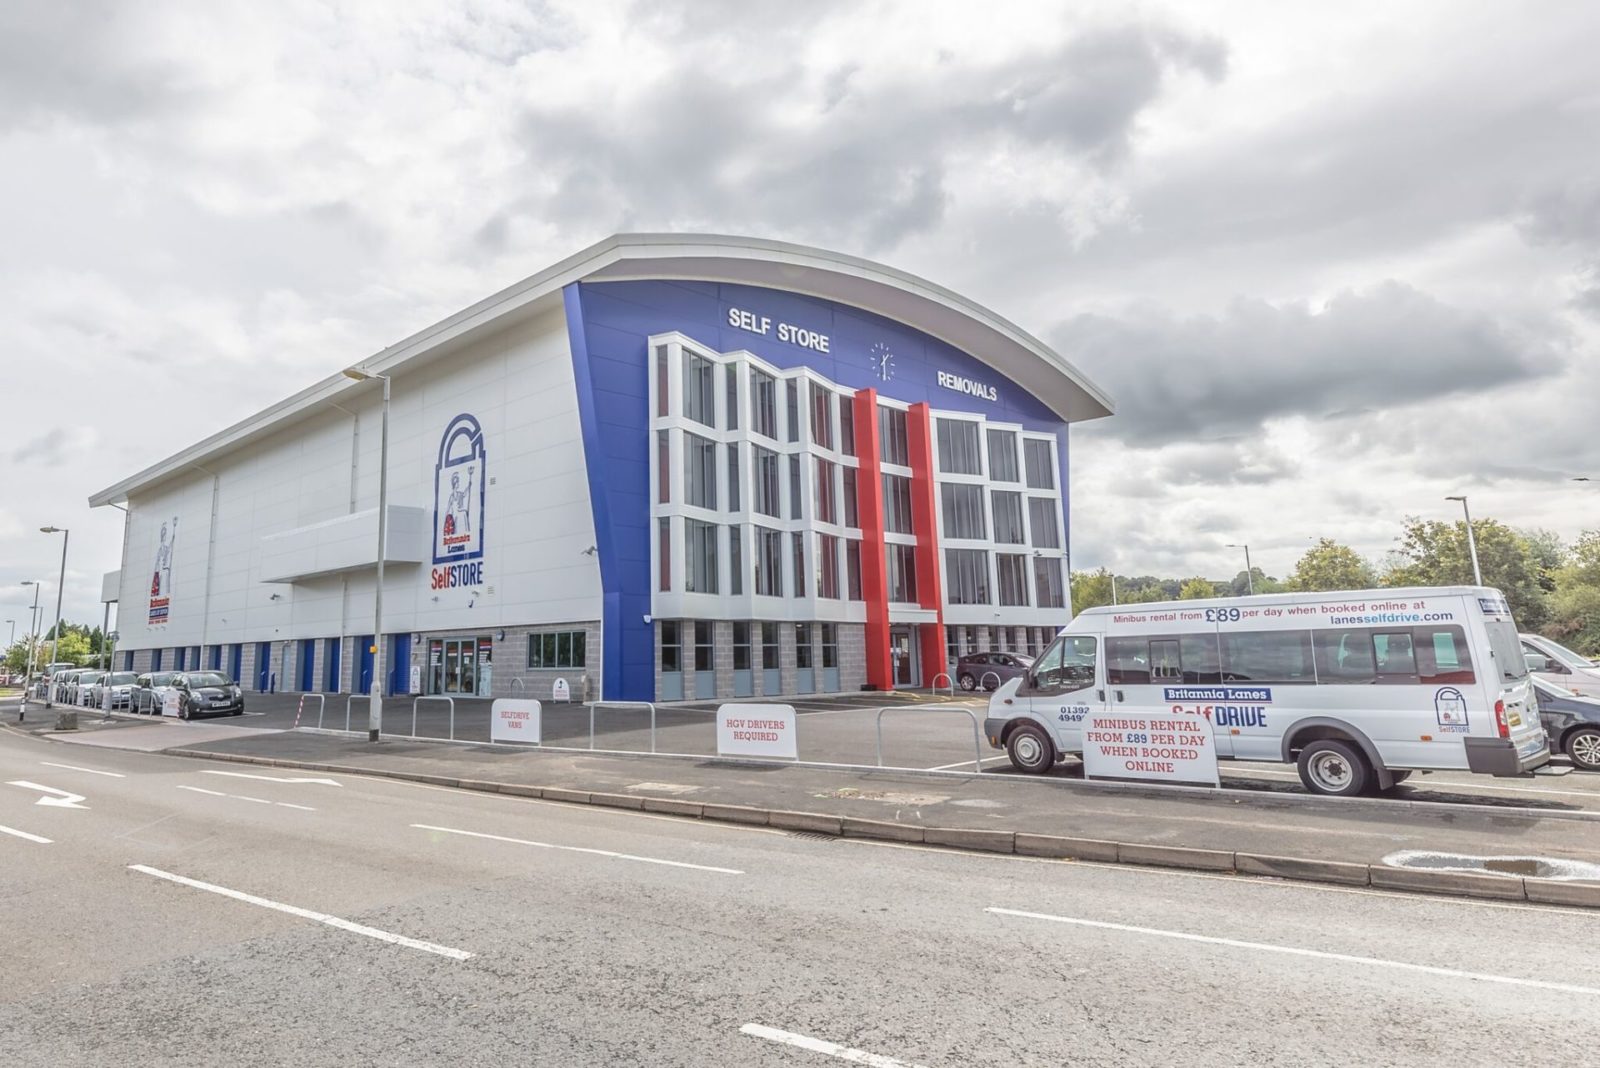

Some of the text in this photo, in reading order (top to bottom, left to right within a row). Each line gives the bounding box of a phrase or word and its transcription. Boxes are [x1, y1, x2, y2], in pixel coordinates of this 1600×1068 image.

[729, 308, 830, 353] SELF STORE
[937, 371, 997, 402] REMOVALS
[431, 561, 484, 590] SelfSTORE
[1113, 600, 1426, 624] Minibus rental from £89 per day when booked online at
[1330, 612, 1454, 626] lanesselfdrive.com
[1167, 689, 1267, 700] Britannia Lanes
[1060, 706, 1090, 714] 01392
[507, 720, 522, 729] VANS
[726, 719, 785, 730] HGV DRIVERS
[1058, 714, 1085, 722] 4949
[1093, 719, 1201, 732] MINIBUS RENTAL
[733, 731, 778, 742] REQUIRED
[1087, 732, 1206, 746] FROM £89 PER DAY
[1100, 746, 1198, 760] WHEN BOOKED
[1125, 760, 1175, 773] ONLINE
